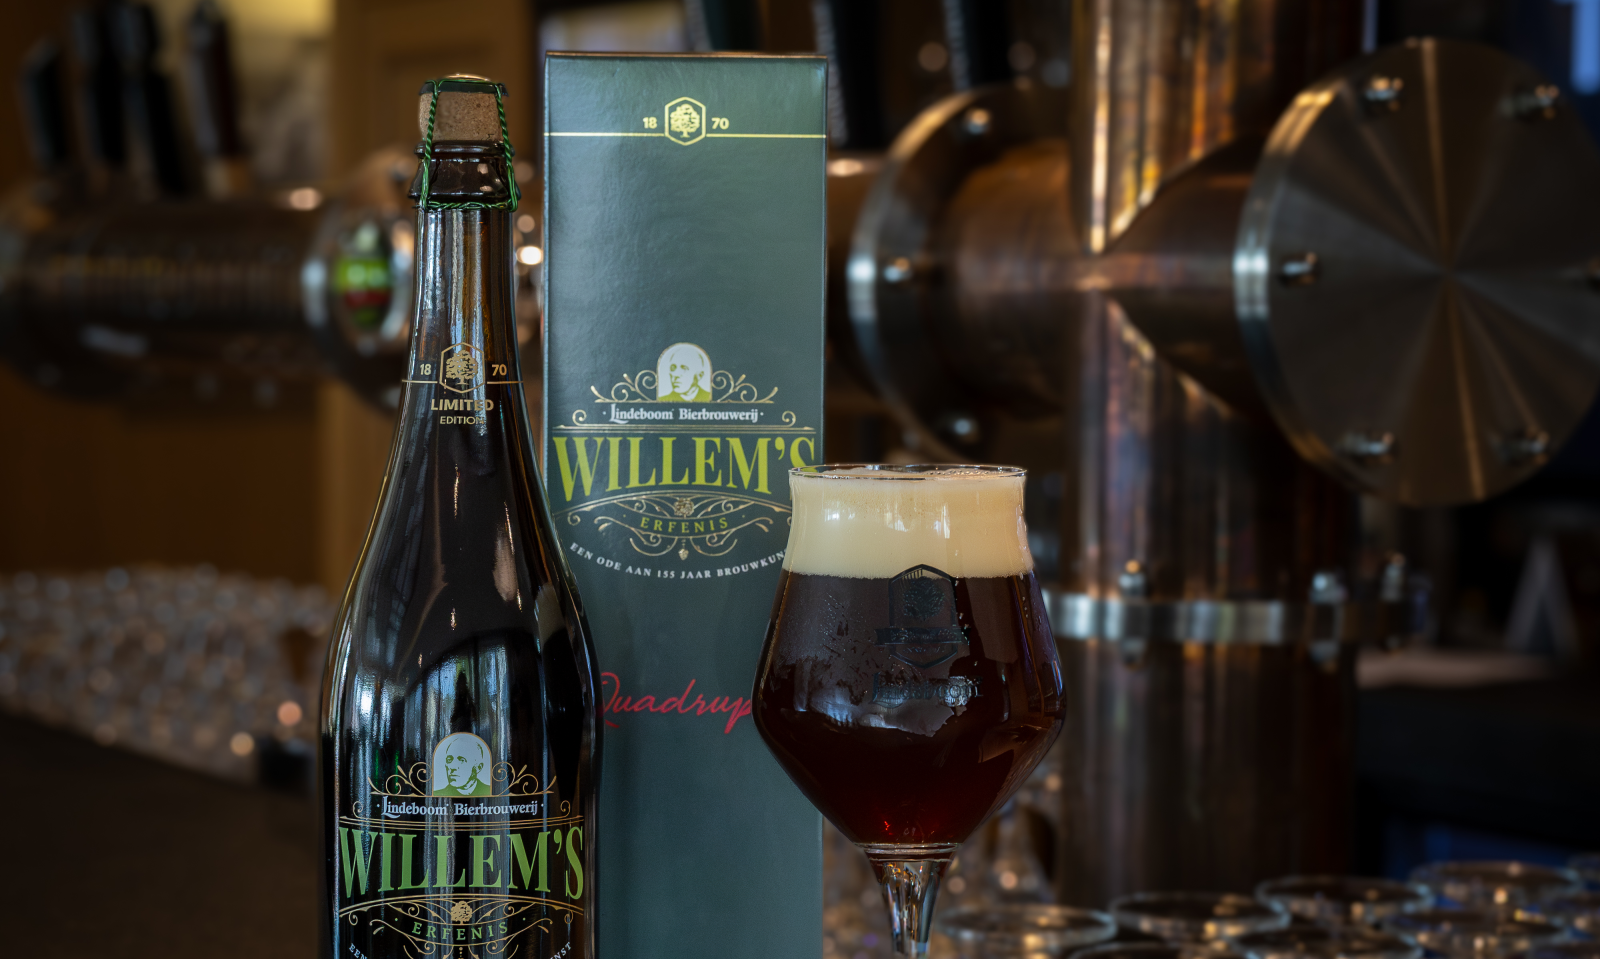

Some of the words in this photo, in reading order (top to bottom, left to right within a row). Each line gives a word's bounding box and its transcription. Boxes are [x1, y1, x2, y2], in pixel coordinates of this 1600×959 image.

[642, 116, 658, 129] 18
[711, 117, 730, 130] 70
[419, 363, 432, 376] 18
[491, 363, 508, 376] 70
[430, 399, 495, 411] LIMITED
[609, 403, 674, 424] Lindeboom
[679, 407, 759, 423] Bierbrouwerij
[440, 415, 485, 425] EDITION
[640, 516, 729, 533] ERFENIS
[569, 542, 593, 560] EEN
[596, 556, 622, 571] ODE
[625, 565, 652, 577] AAN
[657, 570, 675, 579] 155
[680, 569, 712, 579] JAAR
[717, 549, 786, 577] BROUWKUN
[381, 795, 448, 819] Lindeboom
[453, 800, 539, 816] Bierbrouwerij
[338, 825, 584, 900] WILLEM'S
[411, 921, 508, 940] ERFENIS
